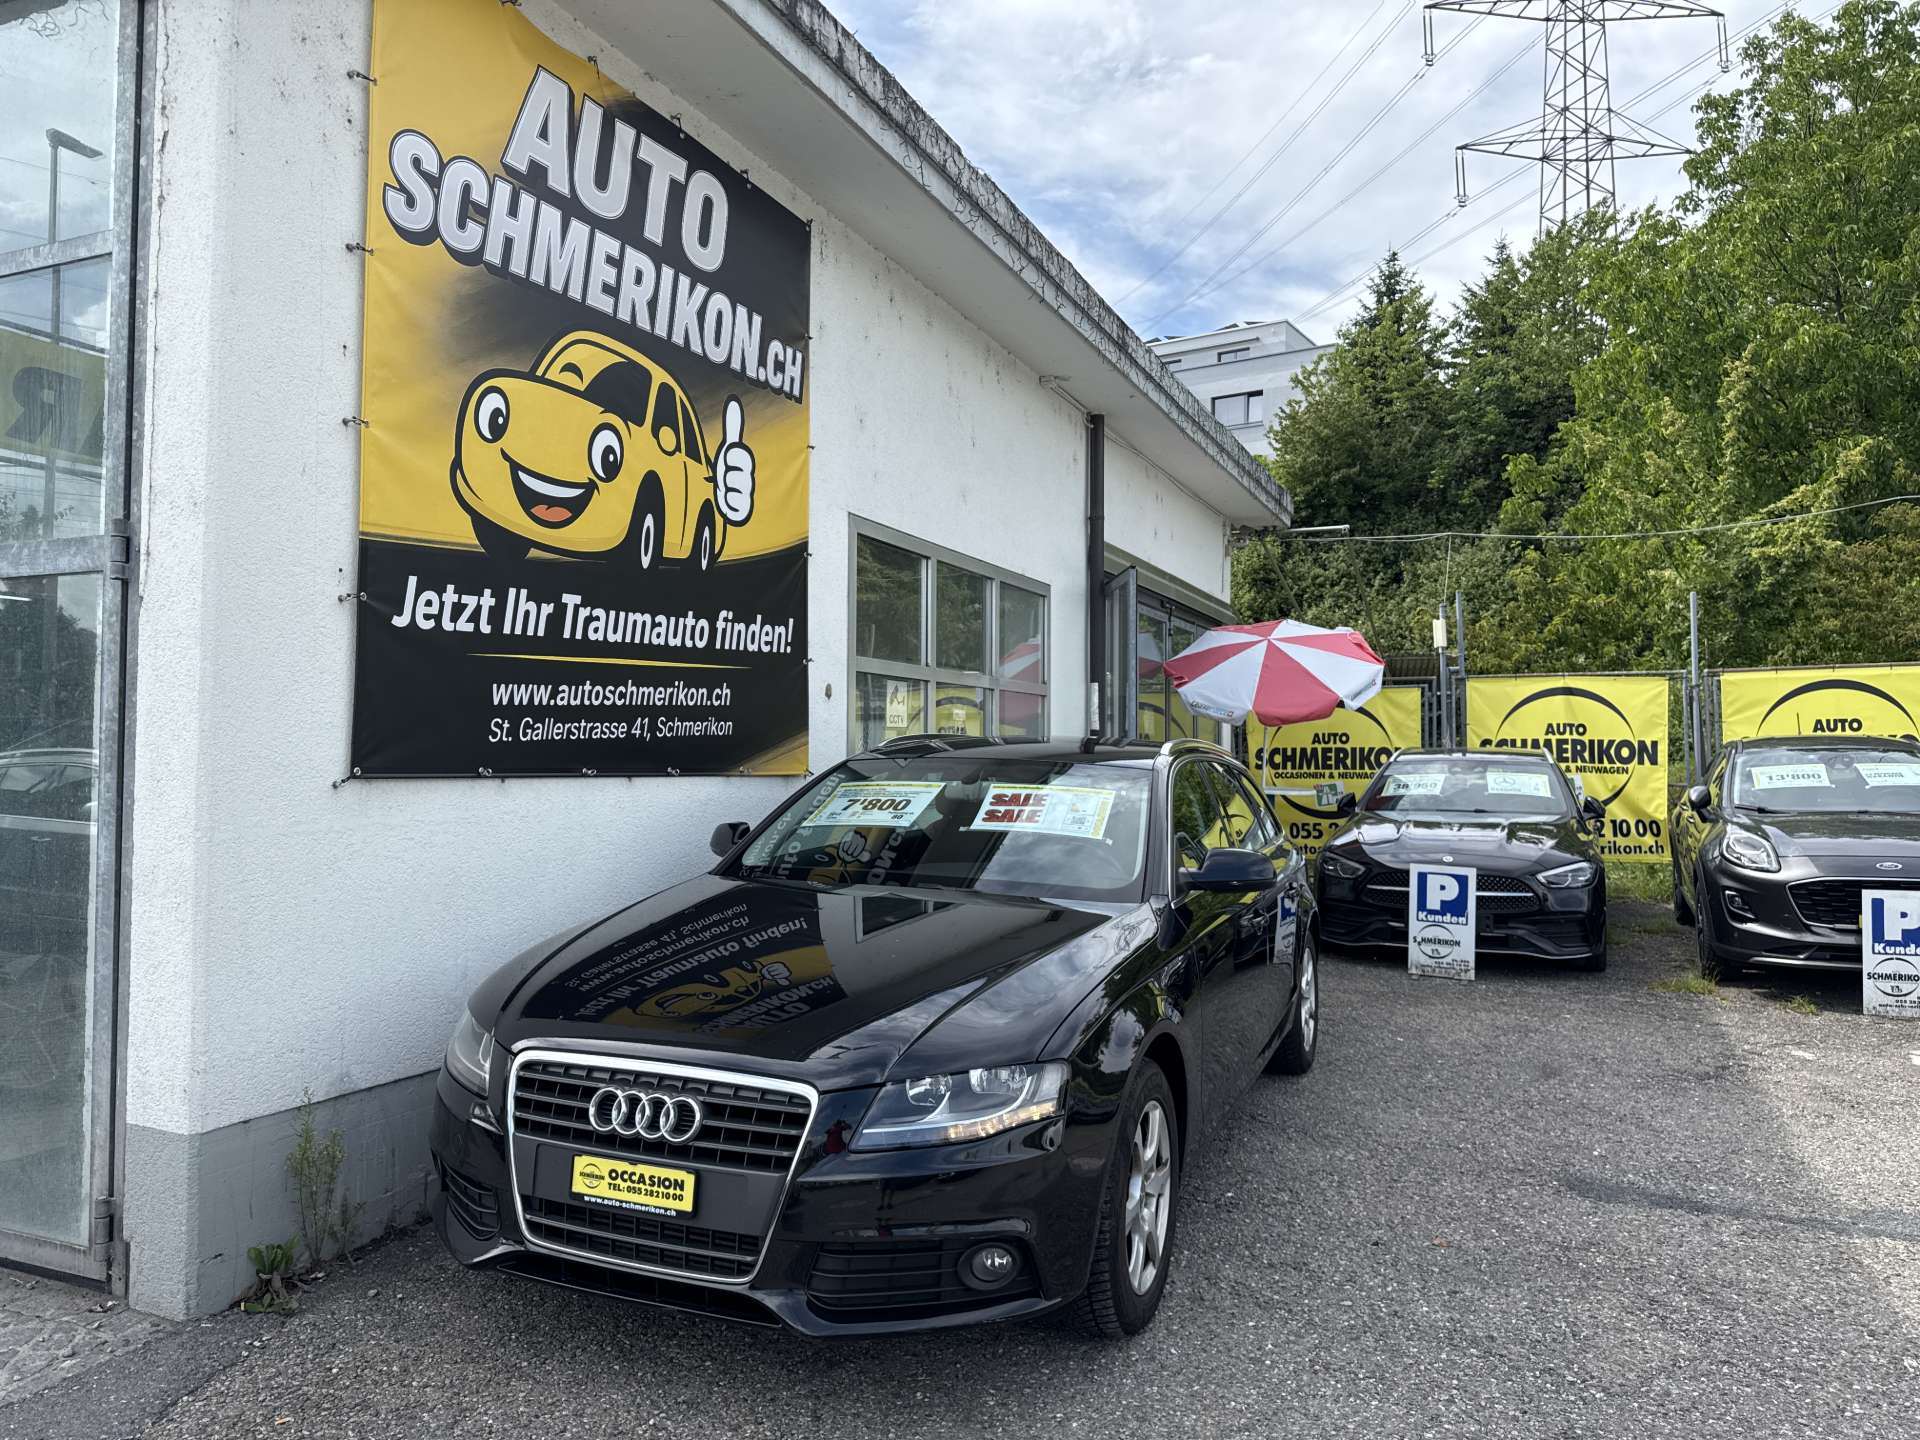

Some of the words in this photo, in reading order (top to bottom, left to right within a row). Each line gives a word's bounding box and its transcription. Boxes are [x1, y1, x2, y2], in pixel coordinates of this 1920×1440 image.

[501, 65, 728, 272] AUTO
[385, 131, 803, 397] SCHMERIKON.CH
[391, 575, 495, 634] Jetzt
[503, 588, 554, 637] Ihr
[561, 594, 709, 649] Traumauto
[714, 610, 794, 654] finden!
[491, 680, 731, 707] www.autoschmerikon.ch
[489, 718, 512, 743] St.
[519, 718, 627, 741] Gallerstrasse
[631, 718, 651, 742] 41,
[656, 717, 733, 738] Schmerikon
[1545, 723, 1587, 736] AUTO
[1812, 719, 1863, 733] AUTO
[1311, 733, 1350, 745] AUTO
[1255, 747, 1402, 771] SCHMERIKO
[1273, 772, 1326, 780] OCCASIONEN
[1338, 772, 1376, 780] NEUWAG
[1576, 766, 1629, 775] NEUWAGEN
[841, 798, 911, 811] 7'800
[989, 793, 1049, 807] SALE
[982, 809, 1043, 823] SALE
[1290, 823, 1324, 839] 055
[1610, 819, 1631, 838] 10
[1635, 819, 1661, 838] 00
[1600, 841, 1665, 854] rikon.ch
[1426, 873, 1460, 910] P
[1418, 911, 1467, 925] Kunden
[1874, 943, 1920, 954] Kund
[1867, 971, 1920, 982] SCHMERIKO
[608, 1168, 685, 1192] OCCASION
[607, 1182, 625, 1193] TEL:
[626, 1187, 642, 1196] 055
[583, 1196, 677, 1217] www.auto-schmerikon.ch
